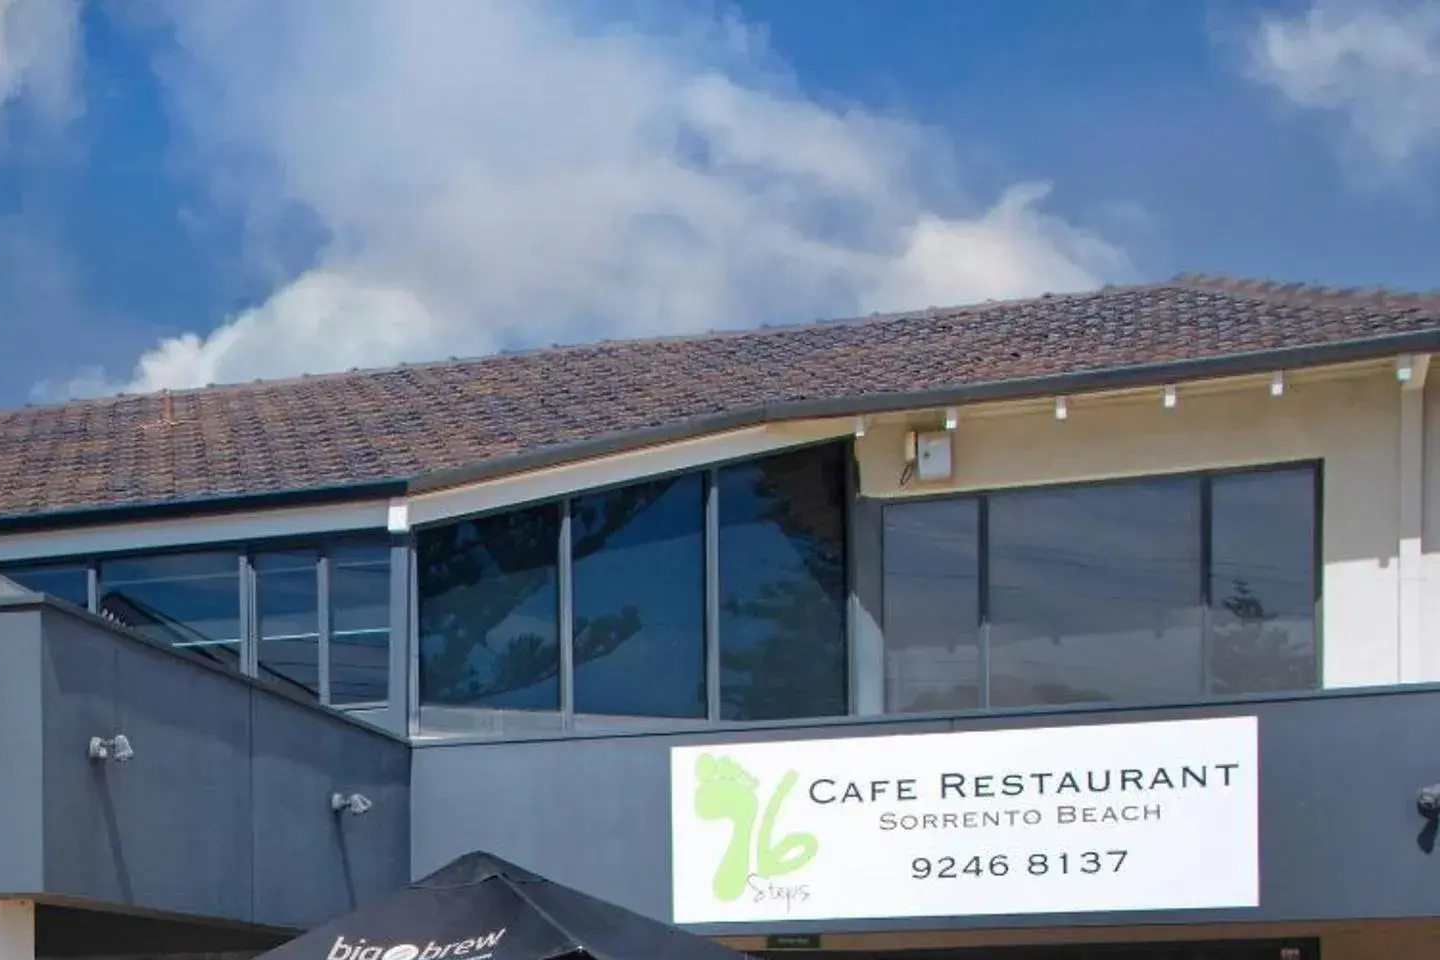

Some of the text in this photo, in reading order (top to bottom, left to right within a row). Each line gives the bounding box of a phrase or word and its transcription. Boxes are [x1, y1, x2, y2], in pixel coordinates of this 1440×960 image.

[809, 764, 1239, 804] CAFE RESTAURANT
[879, 804, 1161, 831] SORRENTO BEACH
[911, 850, 1128, 880] 9246 8137
[418, 928, 506, 960] brew
